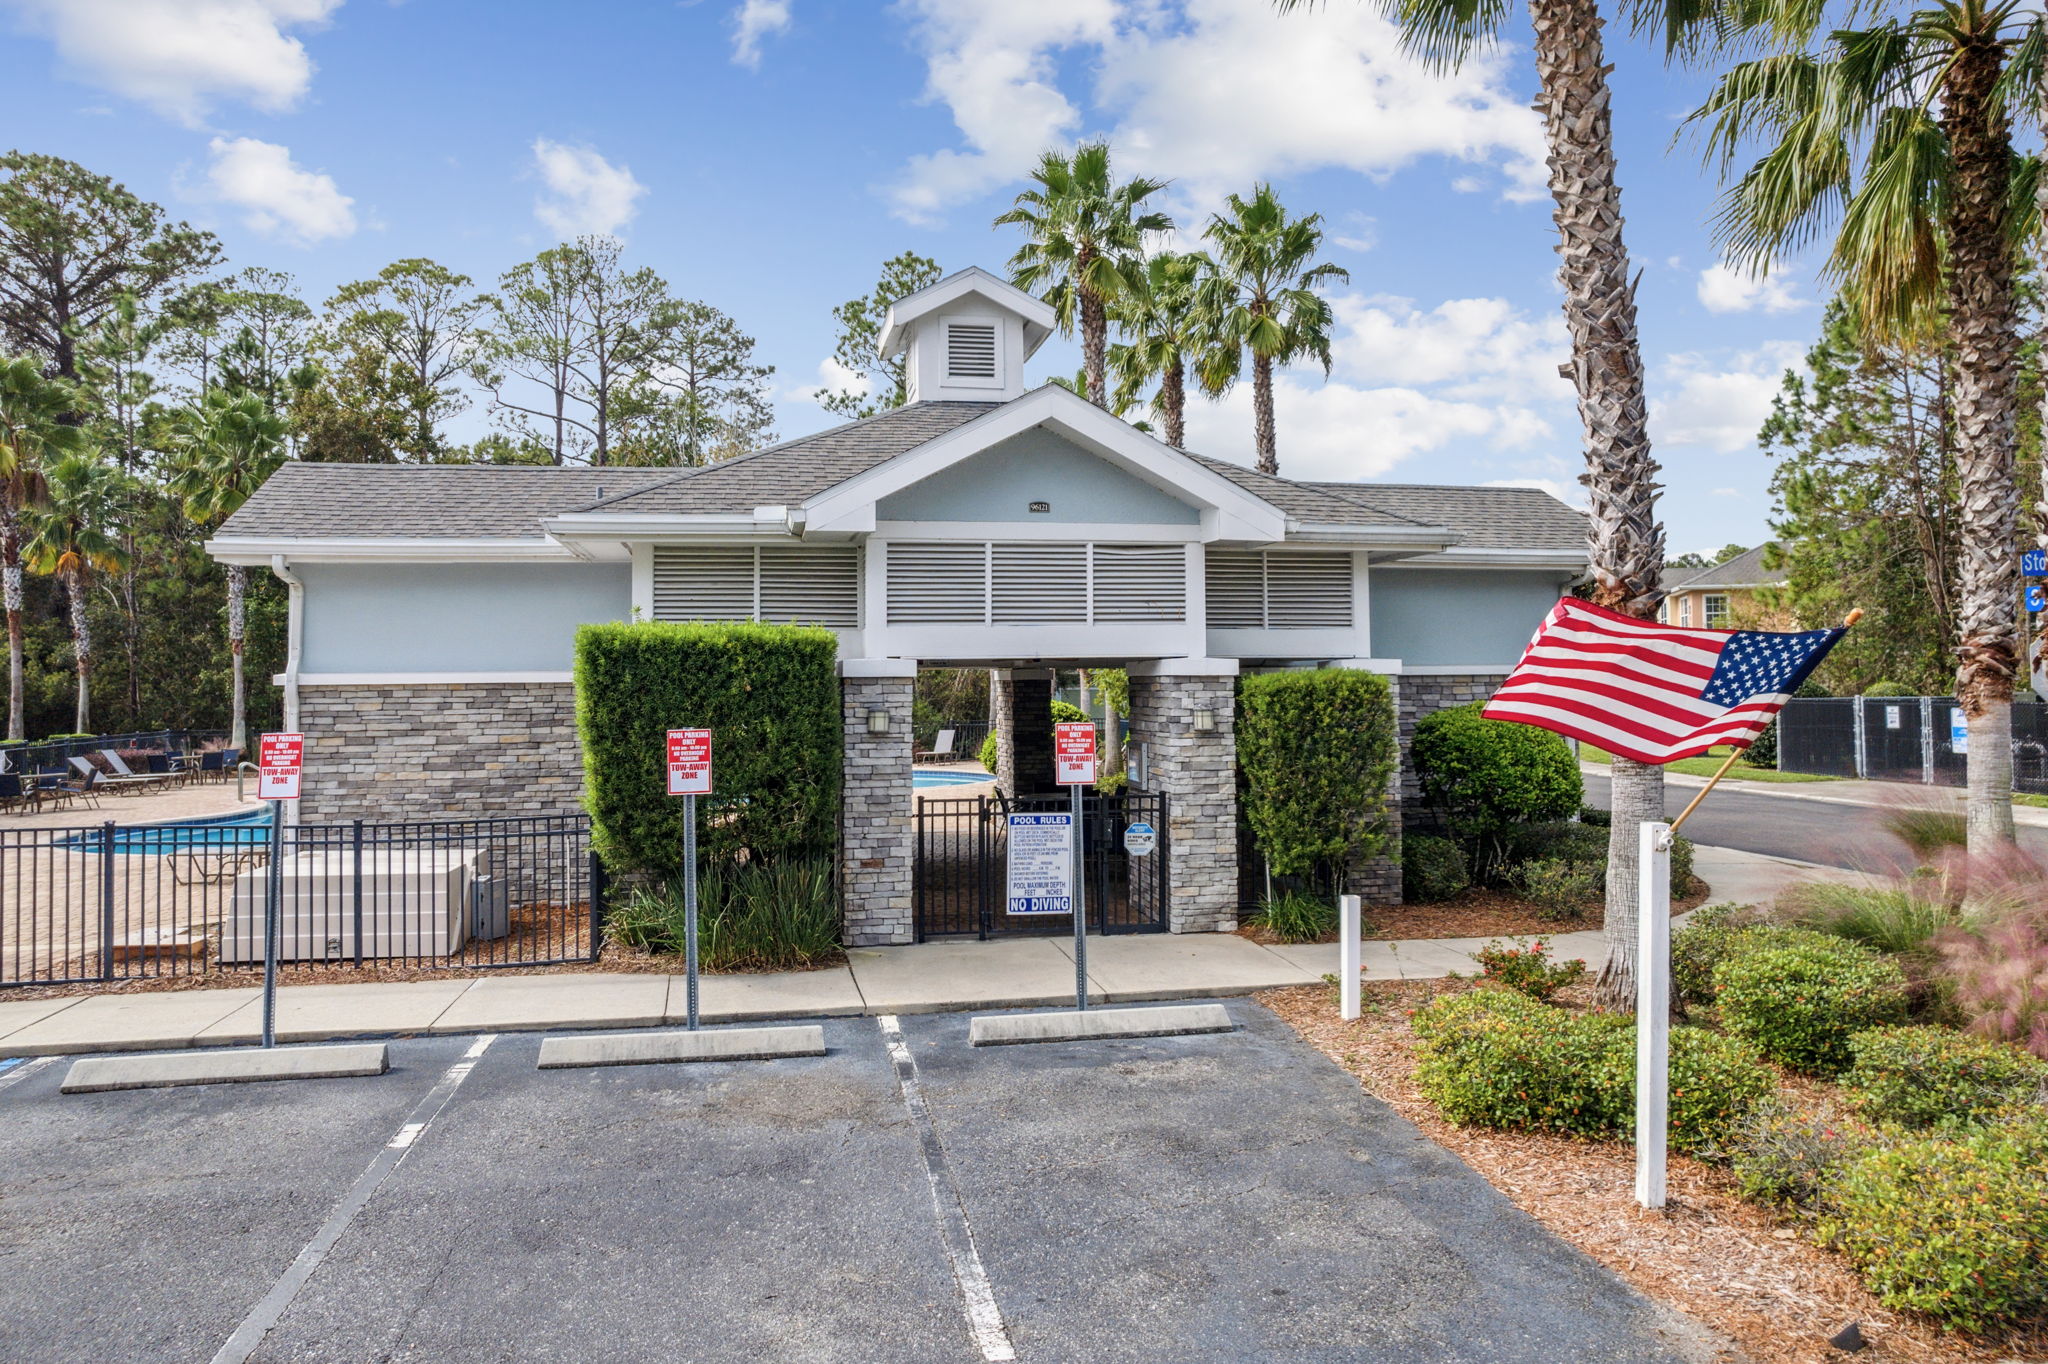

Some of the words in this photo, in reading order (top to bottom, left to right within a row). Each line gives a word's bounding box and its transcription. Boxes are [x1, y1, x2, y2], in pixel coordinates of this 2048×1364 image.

[671, 763, 708, 771] TOW-AWAY
[1011, 898, 1026, 911] NO
[1032, 898, 1068, 910] DIVING
